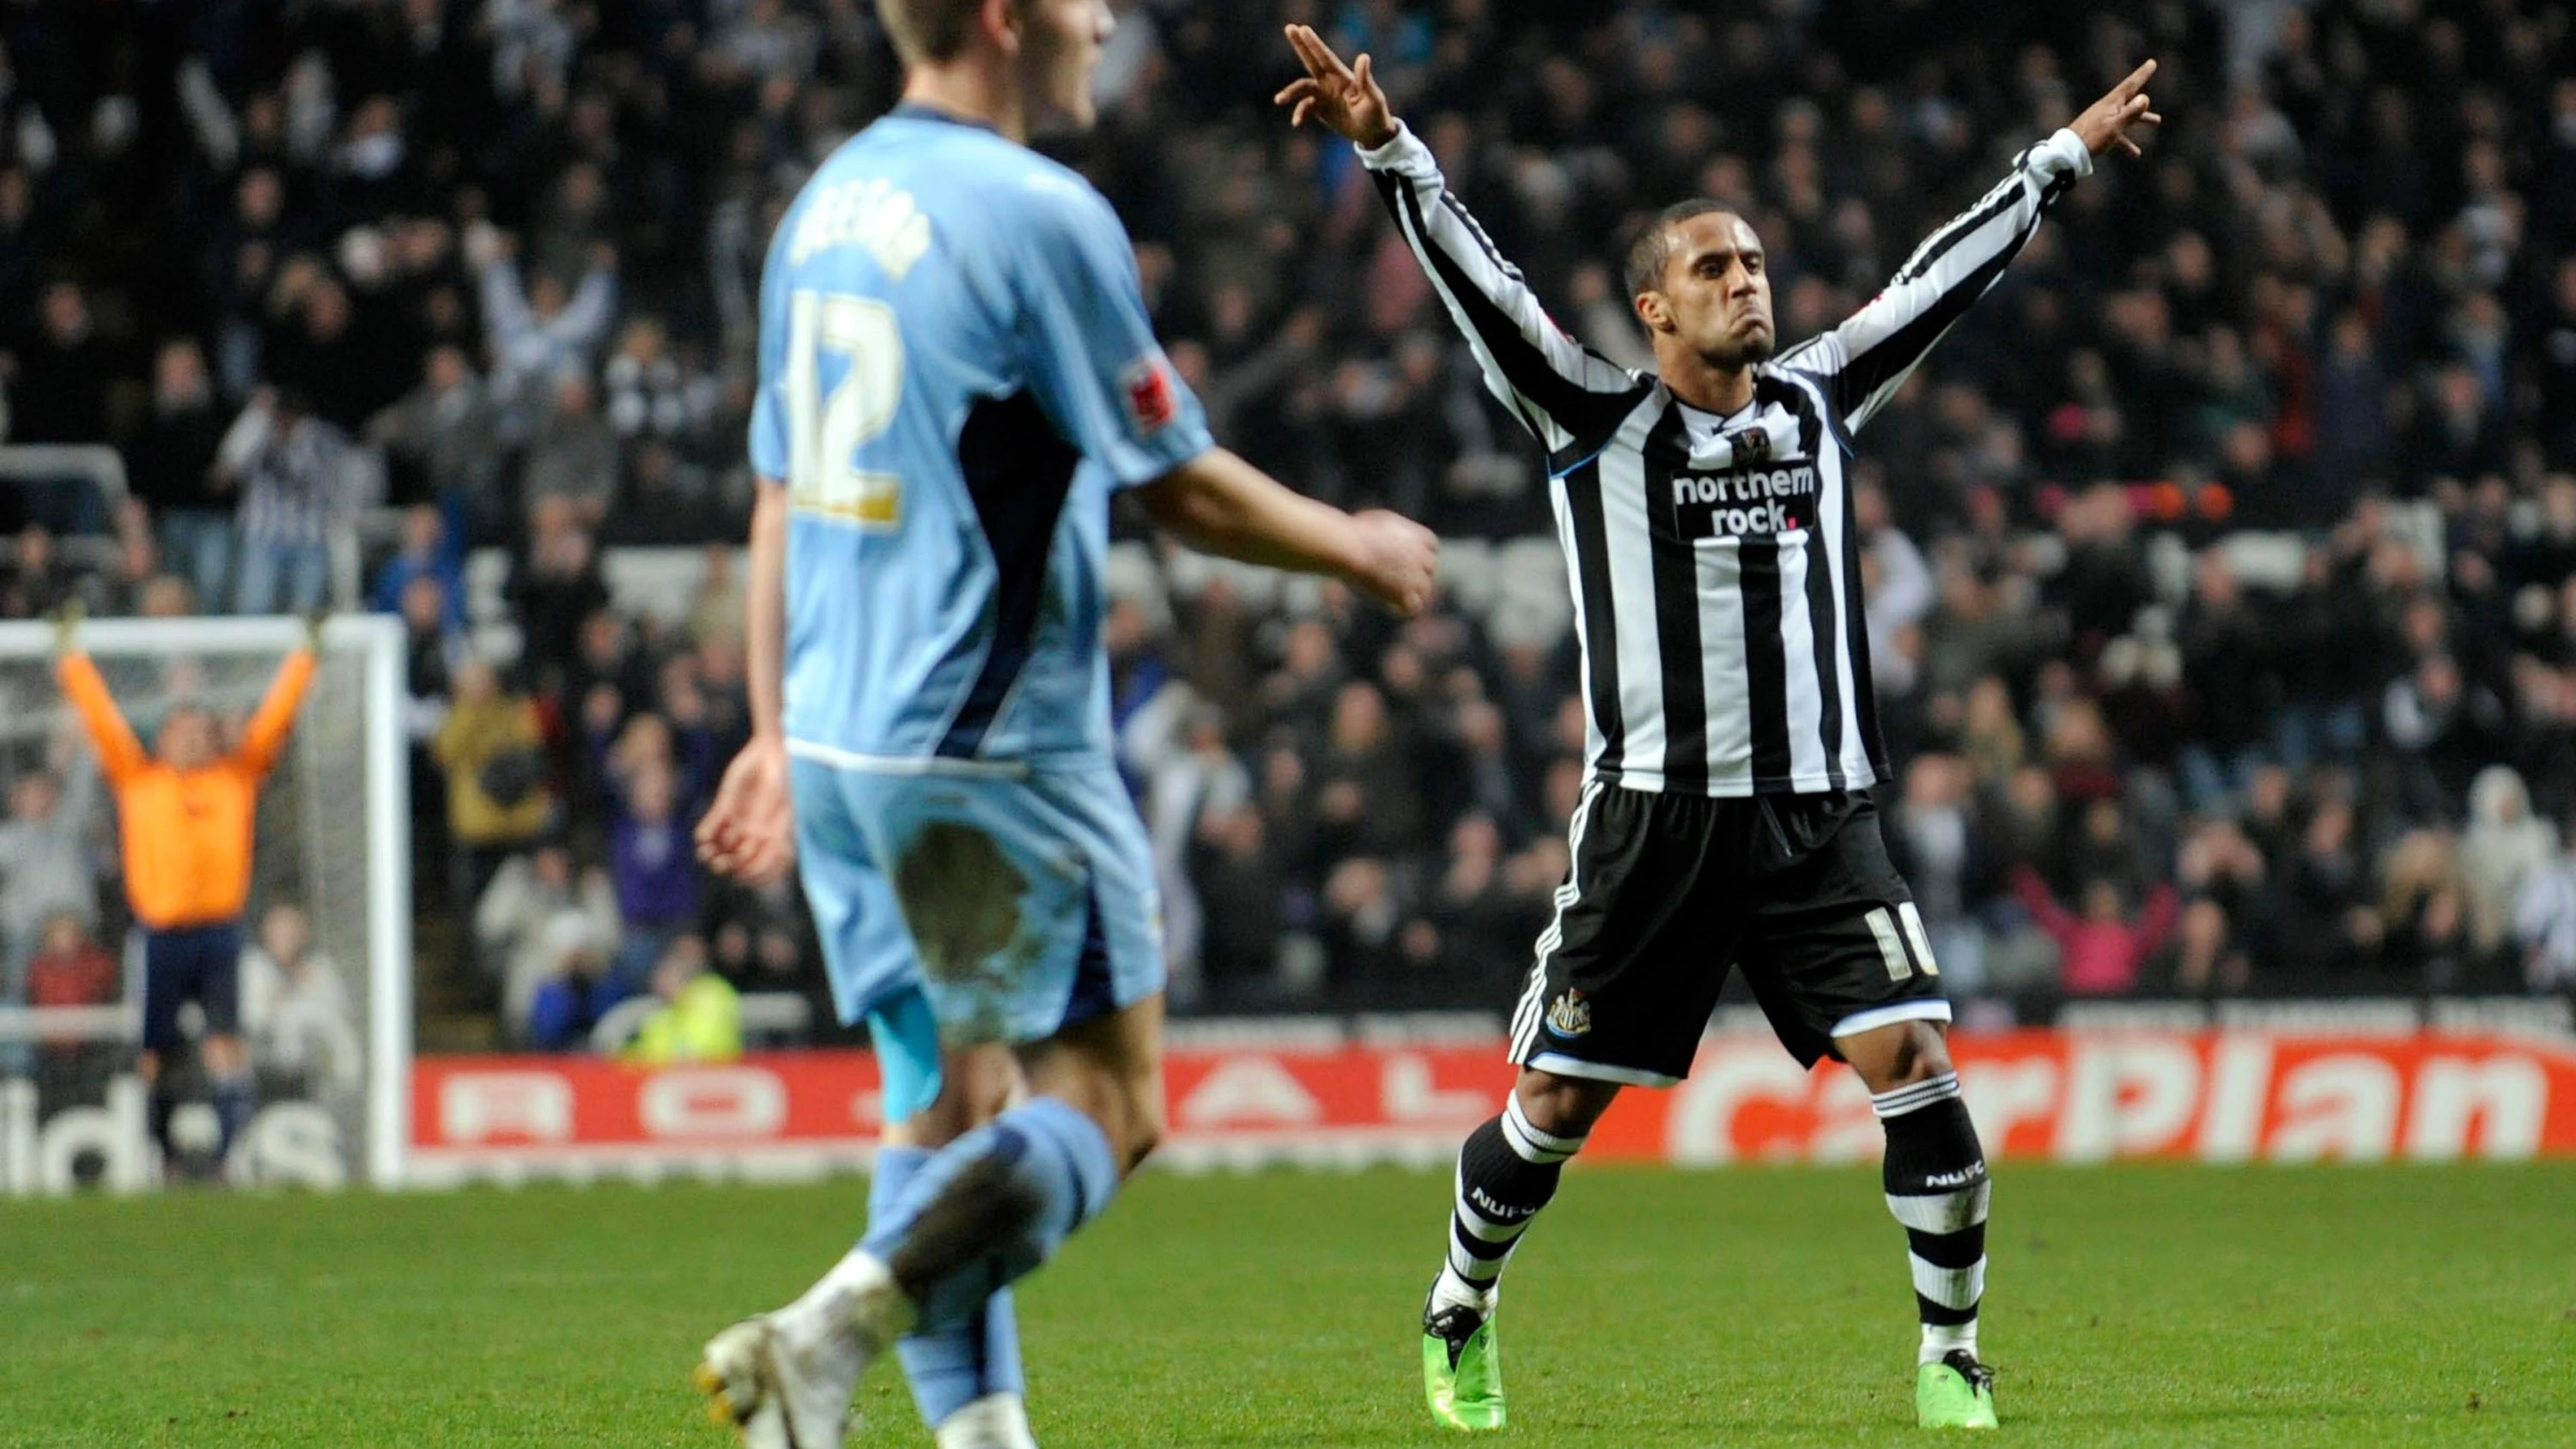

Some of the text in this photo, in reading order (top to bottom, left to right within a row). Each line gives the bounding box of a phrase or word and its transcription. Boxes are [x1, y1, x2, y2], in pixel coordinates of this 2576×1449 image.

[786, 288, 902, 530] 12
[1674, 466, 1814, 505] northern
[1711, 498, 1797, 536] rock.
